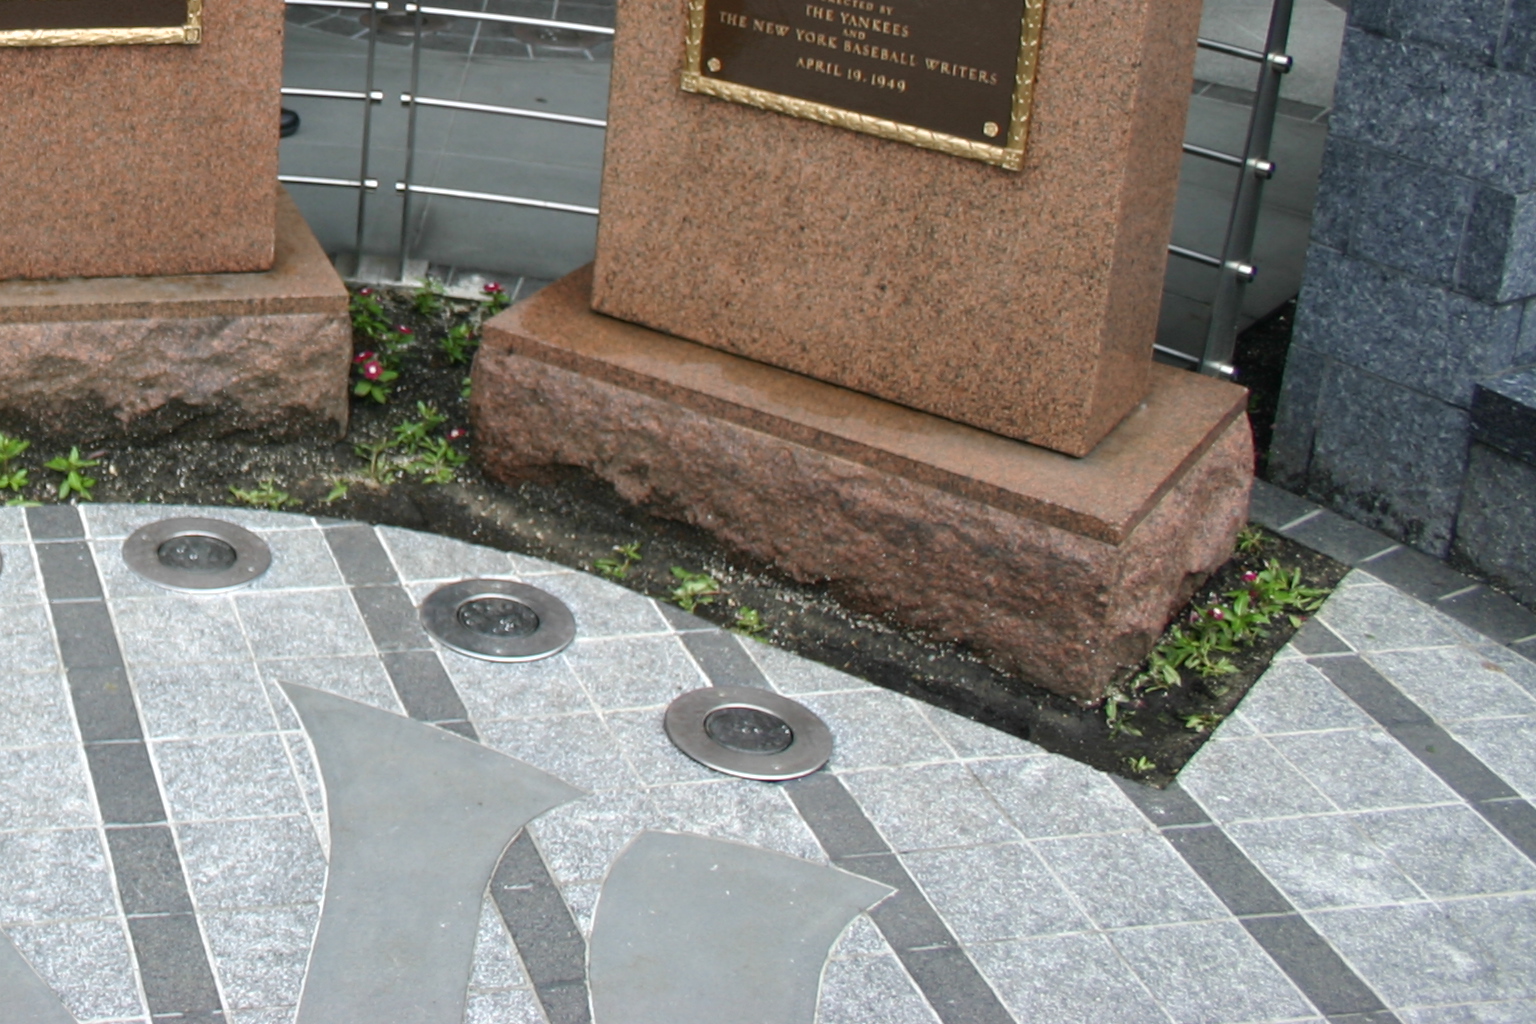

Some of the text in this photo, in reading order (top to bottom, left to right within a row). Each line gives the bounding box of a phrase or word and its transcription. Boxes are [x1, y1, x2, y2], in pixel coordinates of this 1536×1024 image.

[806, 4, 909, 38] THE YANKEES
[879, 4, 894, 16] BY
[720, 11, 997, 84] THE NEW YORK BASEBALL WRITERS
[841, 26, 867, 41] AND
[796, 57, 842, 77] APRIL
[870, 73, 906, 92] 1949
